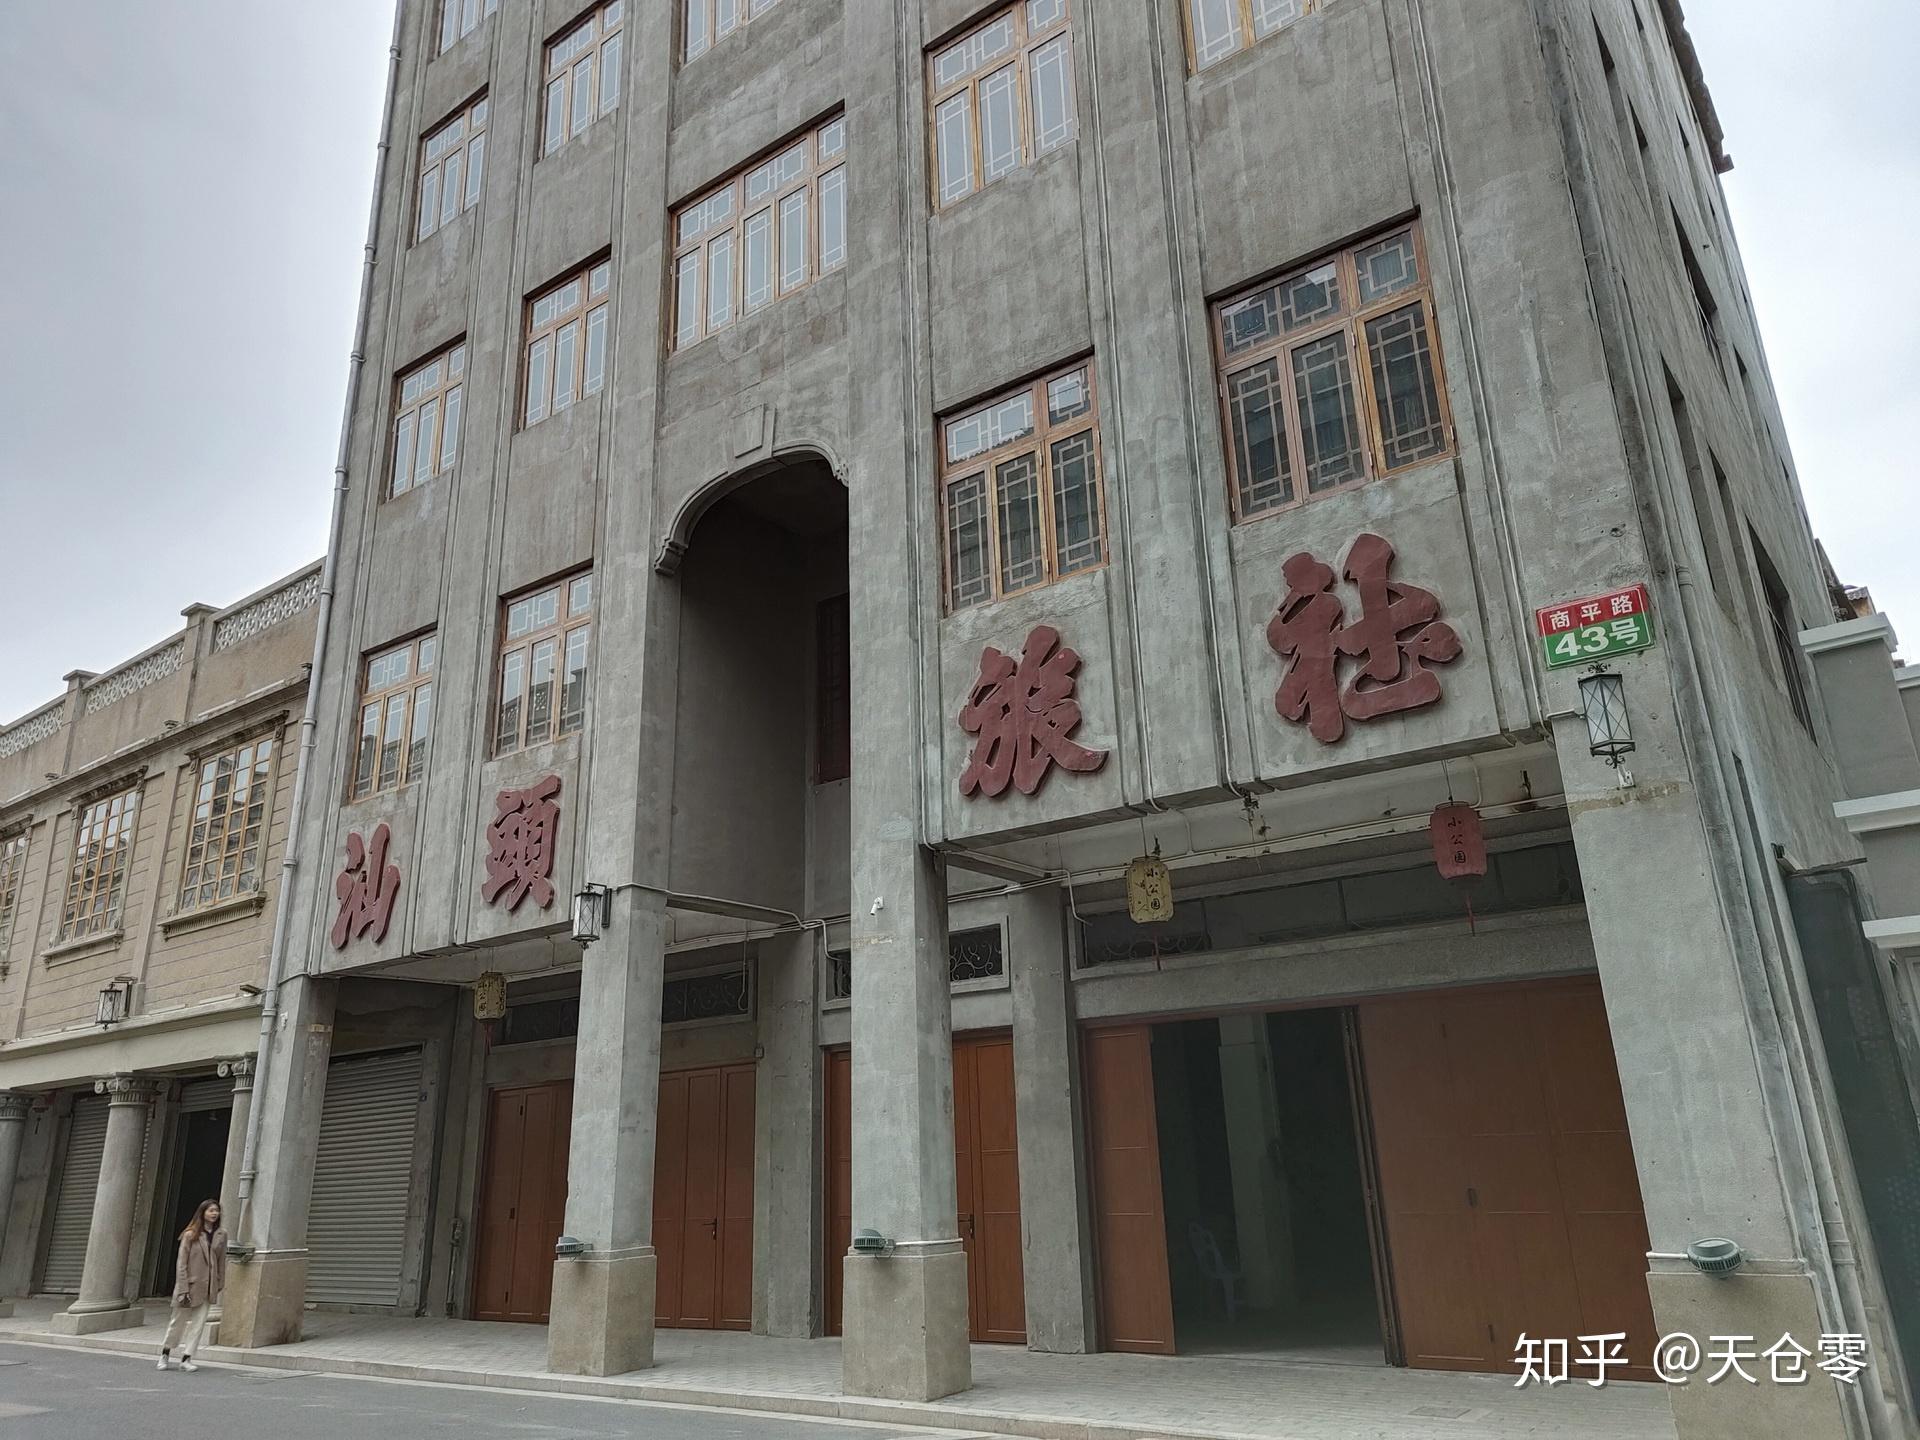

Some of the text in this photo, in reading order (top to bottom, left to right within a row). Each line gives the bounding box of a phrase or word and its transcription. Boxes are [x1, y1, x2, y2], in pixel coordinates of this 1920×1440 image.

[1549, 594, 1634, 631] 商平路
[1554, 617, 1641, 657] 43号
